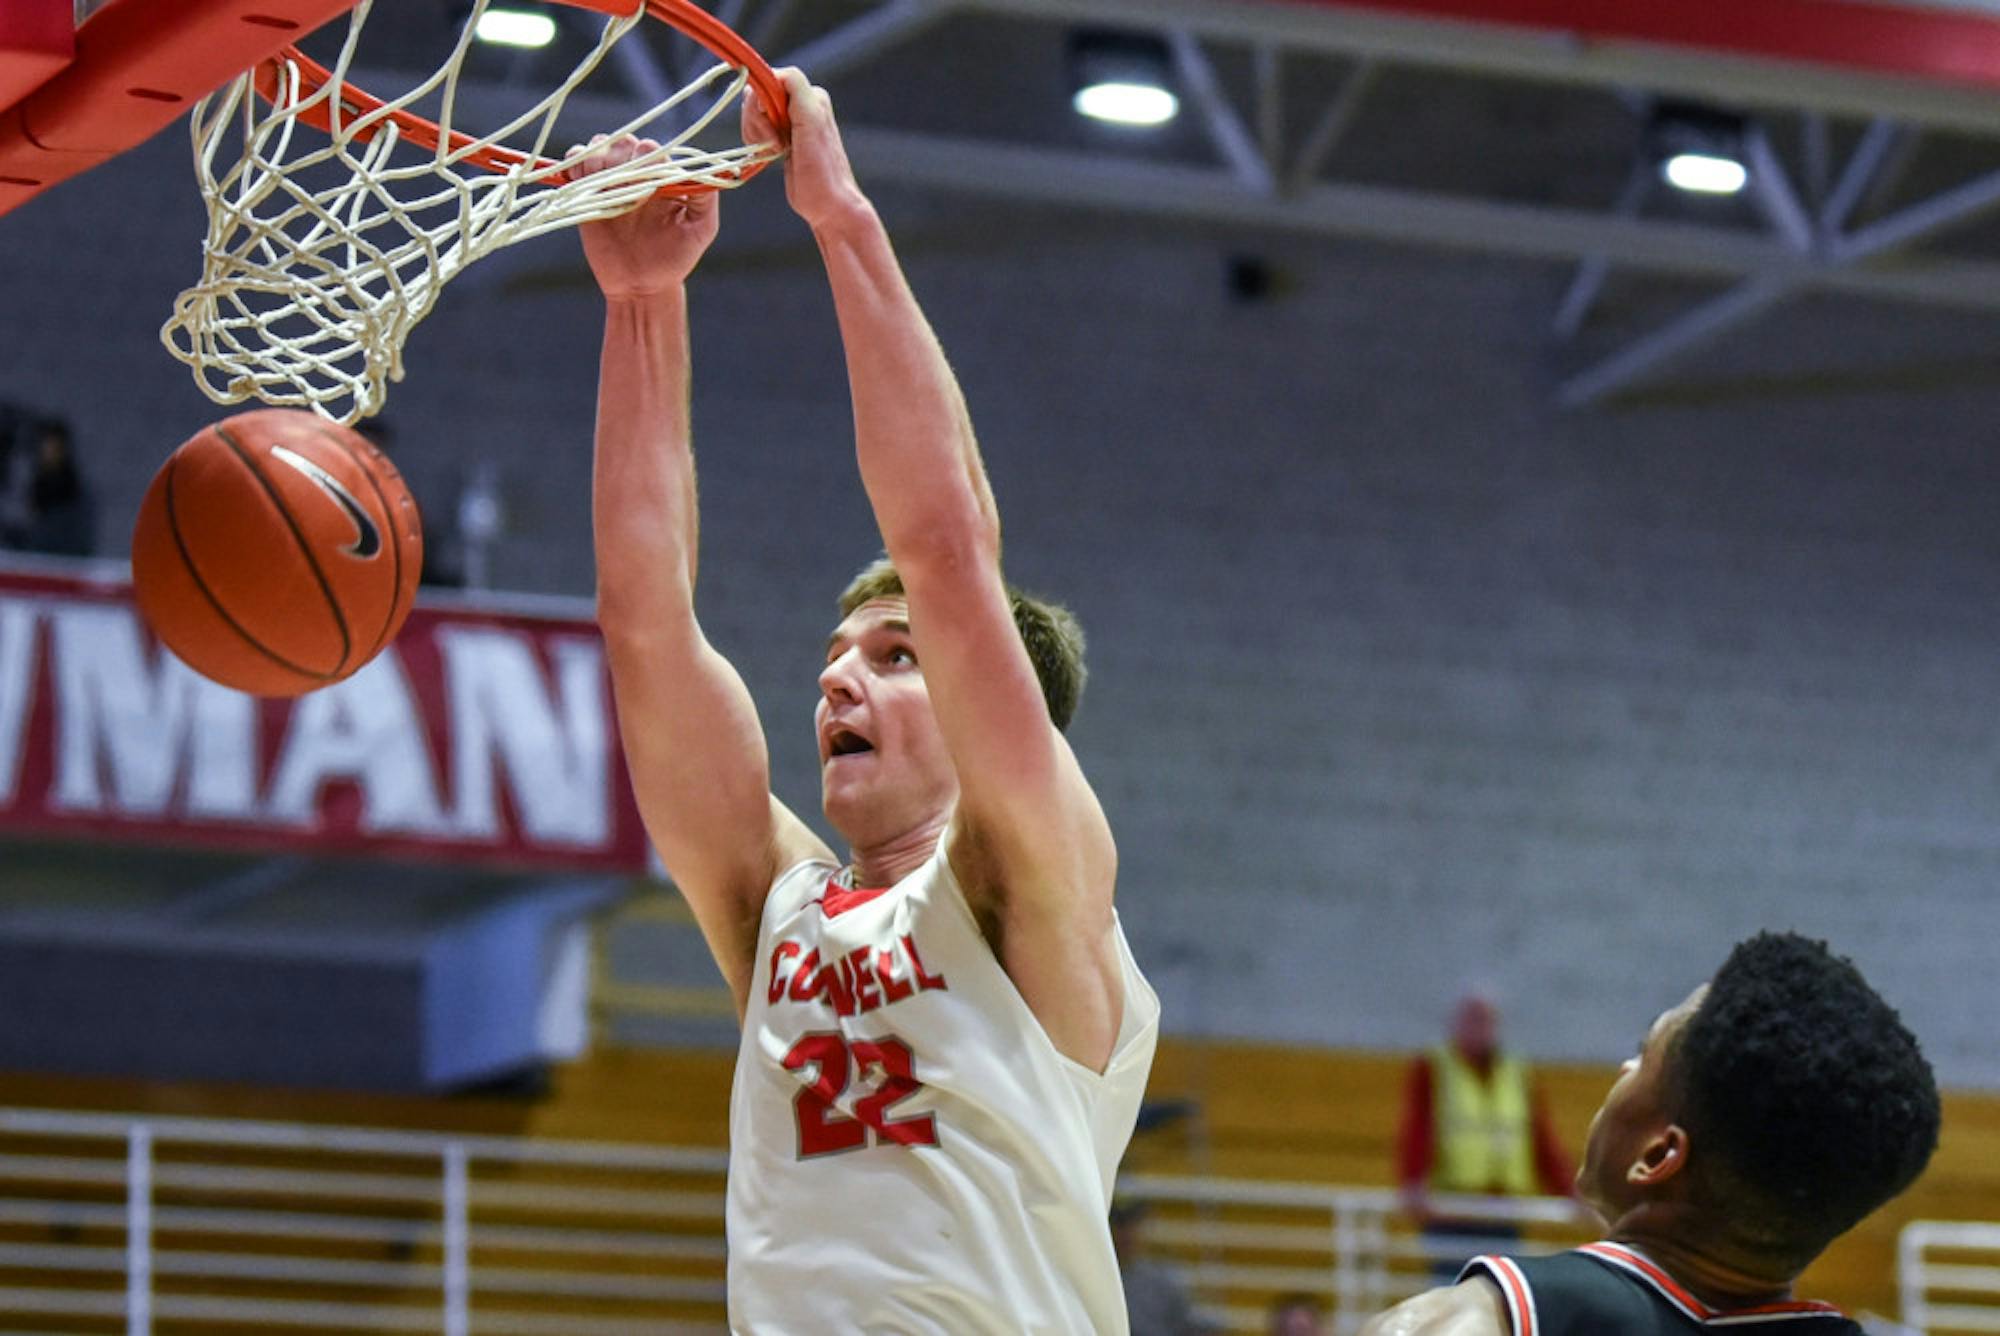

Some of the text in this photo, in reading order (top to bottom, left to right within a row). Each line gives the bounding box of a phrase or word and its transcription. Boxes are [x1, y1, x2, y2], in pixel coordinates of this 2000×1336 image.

[0, 598, 611, 844] MAN
[768, 932, 948, 1017] CONELL
[781, 1030, 941, 1161] 22
